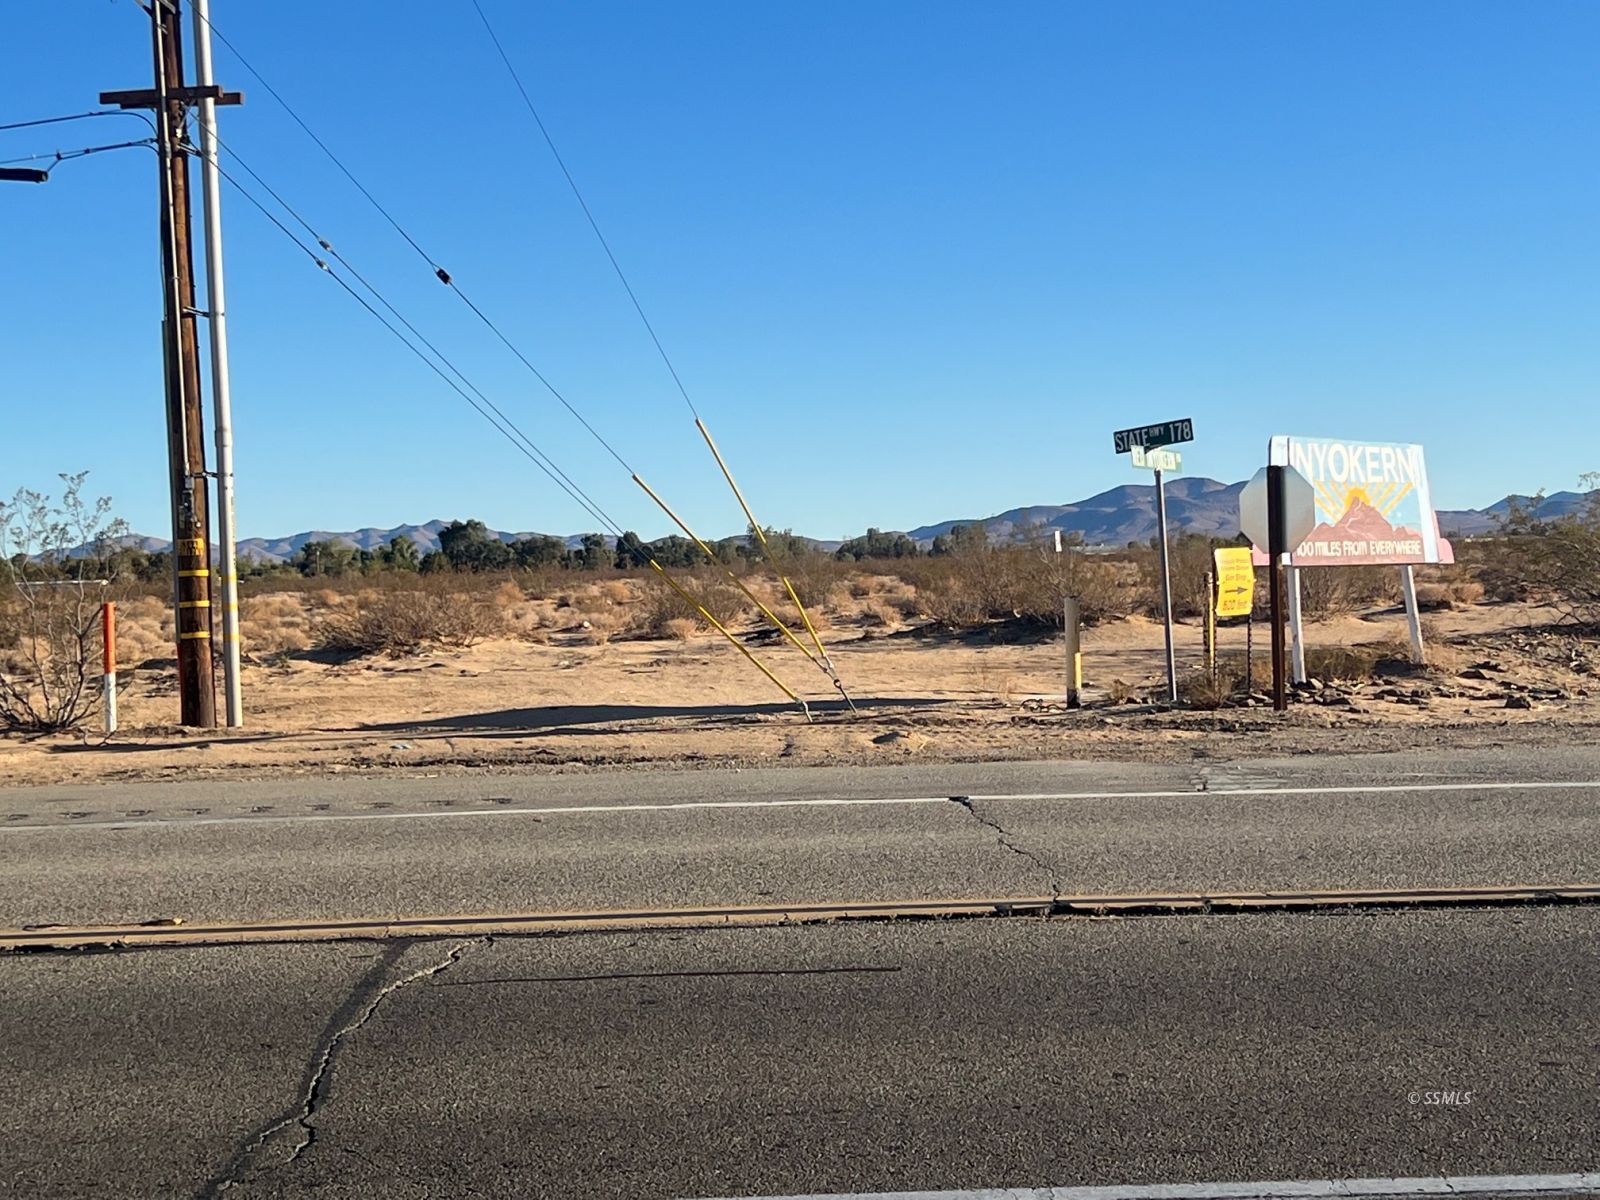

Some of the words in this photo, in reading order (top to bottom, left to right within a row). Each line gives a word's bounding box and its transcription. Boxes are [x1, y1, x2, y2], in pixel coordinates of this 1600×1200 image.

[1115, 429, 1150, 451] STATE
[1150, 426, 1164, 436] HWY
[1169, 422, 1191, 442] 178
[1315, 541, 1341, 556] MILES
[1343, 540, 1367, 556] FROM
[1370, 540, 1422, 555] EVERYWHERE
